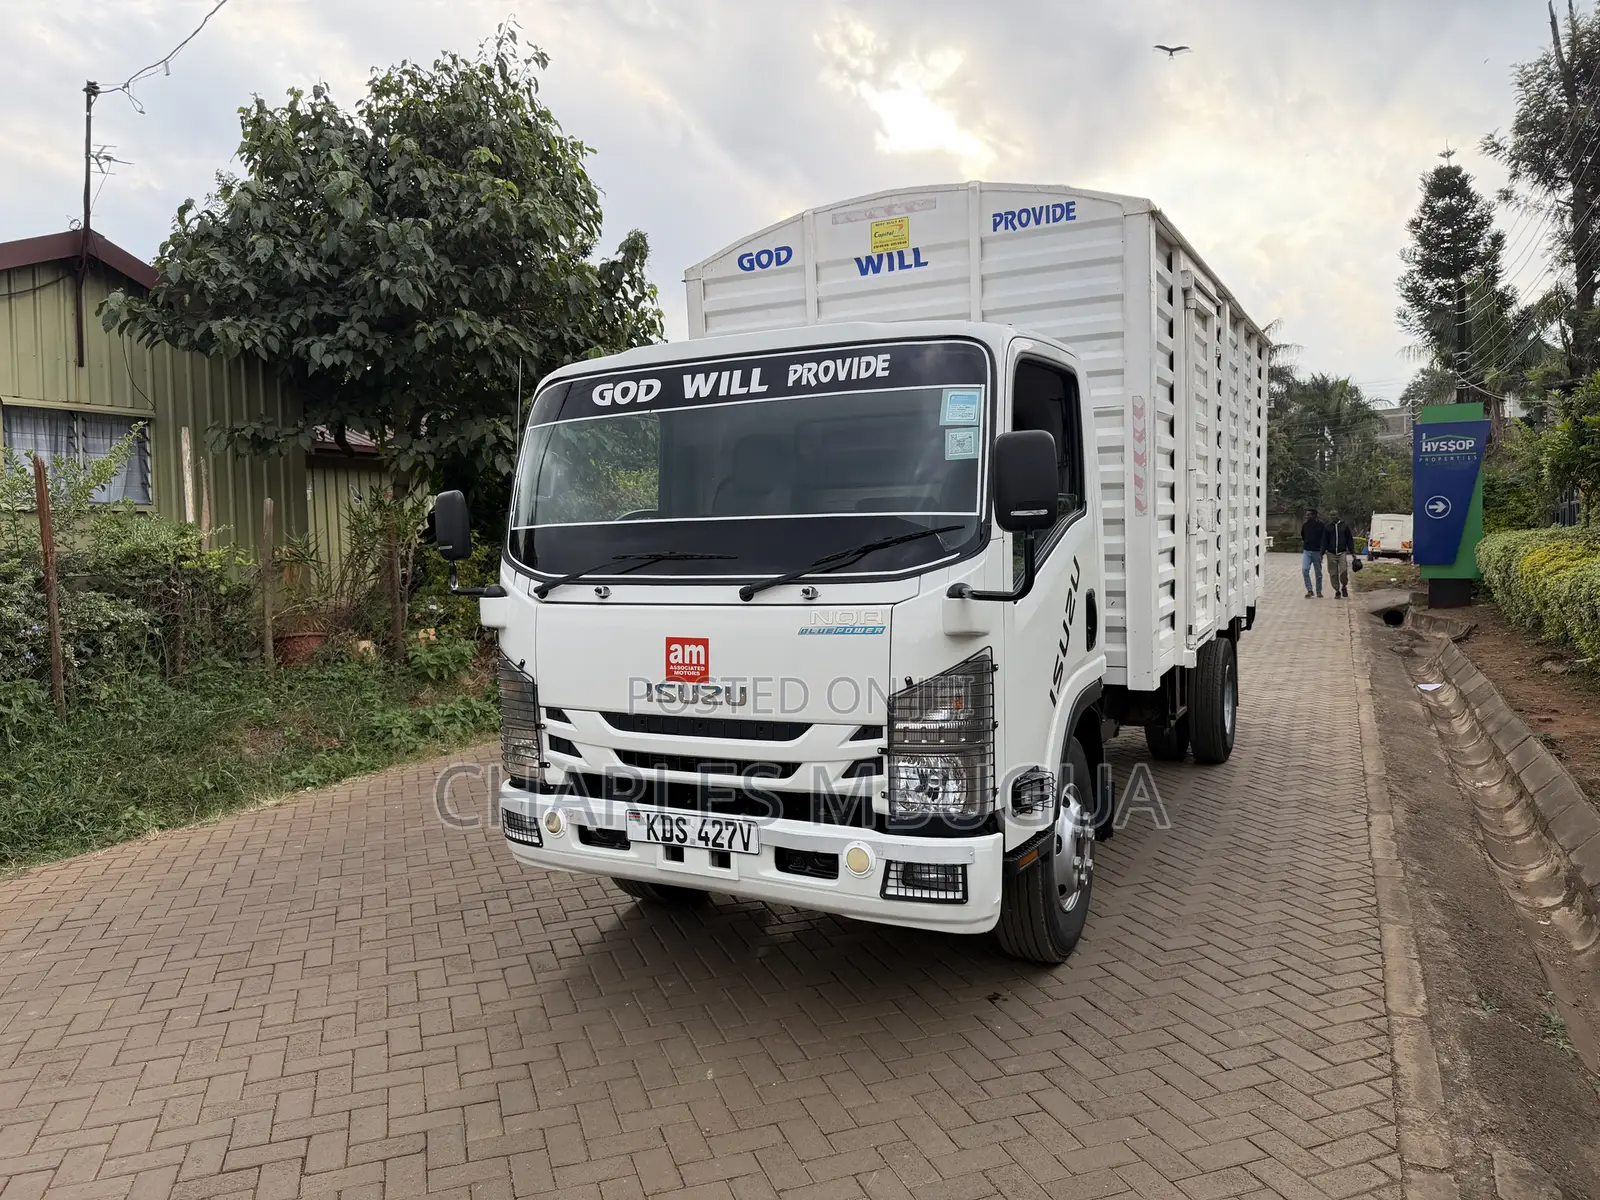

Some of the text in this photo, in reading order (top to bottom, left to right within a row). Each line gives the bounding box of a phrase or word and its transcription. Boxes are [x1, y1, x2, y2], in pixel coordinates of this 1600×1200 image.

[738, 201, 1076, 276] GOD WILL PROVIDE
[592, 354, 891, 406] GOD WILL PROVIDE
[1419, 455, 1478, 463] PROPERTIES
[810, 609, 884, 626] NQR
[1049, 555, 1080, 708] ISUZU
[669, 643, 706, 665] am
[646, 682, 748, 707] ISUZU
[646, 813, 752, 852] KDS 427V
